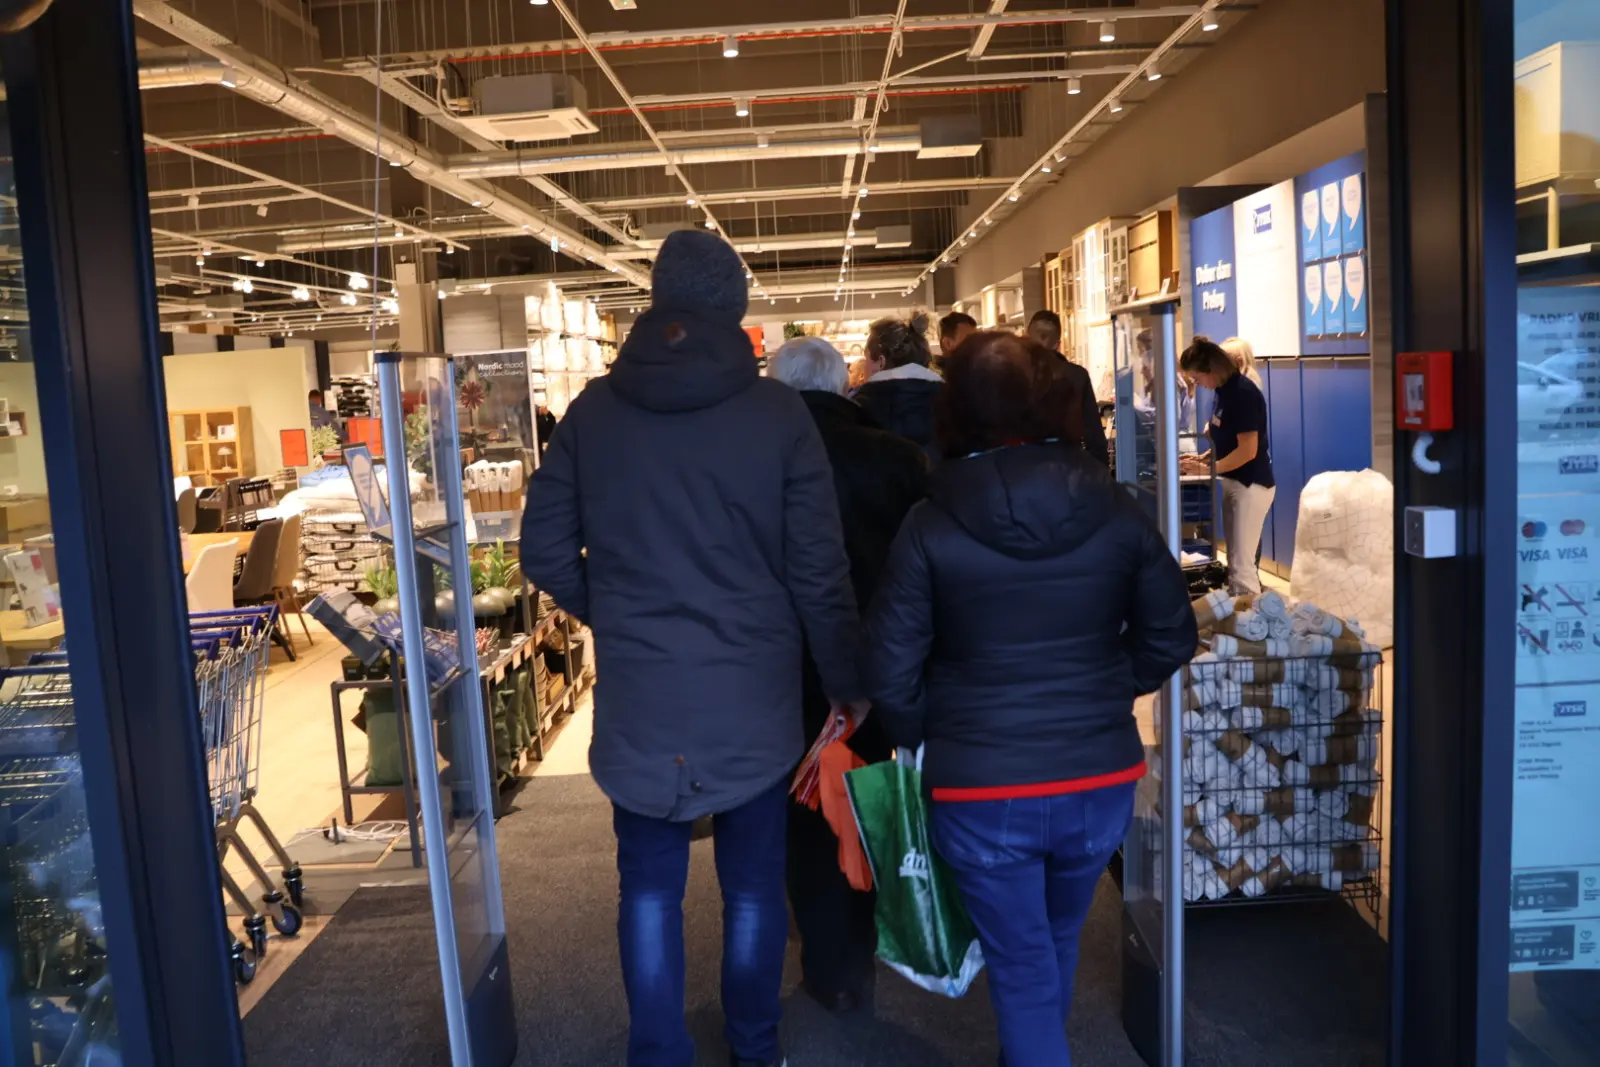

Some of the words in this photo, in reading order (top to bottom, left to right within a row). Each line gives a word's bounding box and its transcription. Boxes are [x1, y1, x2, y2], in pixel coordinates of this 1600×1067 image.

[478, 362, 503, 371] Nordic
[504, 361, 524, 369] mood
[479, 369, 525, 378] collection
[1519, 548, 1551, 562] VISA
[1556, 546, 1589, 560] VISA
